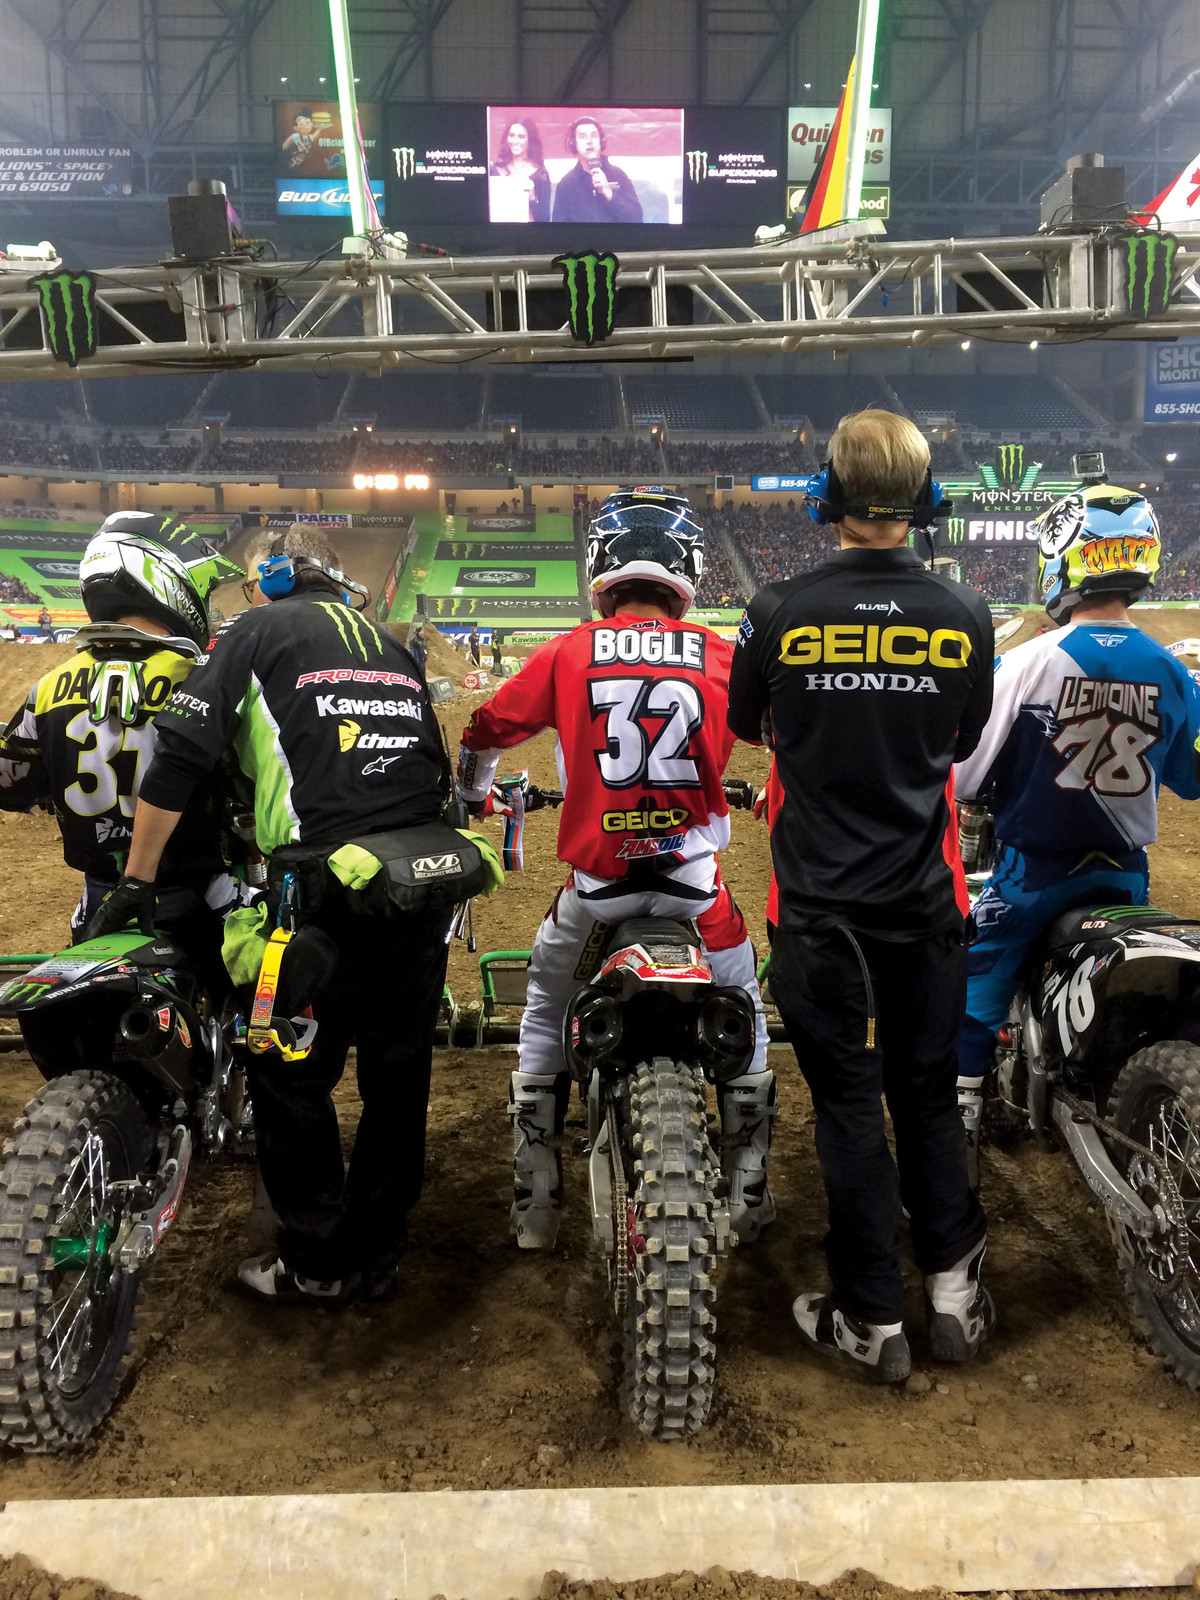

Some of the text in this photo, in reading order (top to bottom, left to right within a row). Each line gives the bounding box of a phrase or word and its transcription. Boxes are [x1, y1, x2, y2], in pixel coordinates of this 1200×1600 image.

[791, 123, 884, 146] Quin
[45, 148, 60, 156] OR
[63, 148, 106, 157] UNRULY
[108, 148, 131, 157] FAN
[14, 171, 25, 181] &
[28, 171, 105, 182] LOCATION
[19, 182, 72, 192] 69050
[278, 191, 383, 203] BUD LIT
[1159, 368, 1200, 382] MORT
[972, 489, 1055, 504] MONSTER
[298, 514, 348, 522] PARTS
[362, 515, 404, 524] MONSTER
[868, 506, 894, 514] GEICO
[968, 520, 1038, 541] FINIS
[511, 636, 551, 644] Kawasaki
[593, 628, 703, 667] BOGLE
[778, 624, 972, 668] GEICO
[296, 669, 353, 690] PRO
[353, 669, 423, 694] CIRCUIT
[805, 672, 941, 693] HONDA
[163, 705, 192, 719] ERGY
[172, 690, 210, 717] STER
[315, 694, 423, 722] Kawasaki
[1057, 678, 1160, 729] LEMOINE
[590, 677, 703, 785] 32
[1052, 712, 1158, 797] 78
[603, 808, 691, 832] GEICO
[614, 832, 686, 860] AMSOIL
[445, 864, 463, 875] WEAR
[1081, 920, 1109, 930] GUTS
[45, 981, 91, 999] DUNLOP
[255, 971, 277, 1020] SCOTT
[1052, 955, 1096, 1058] 78
